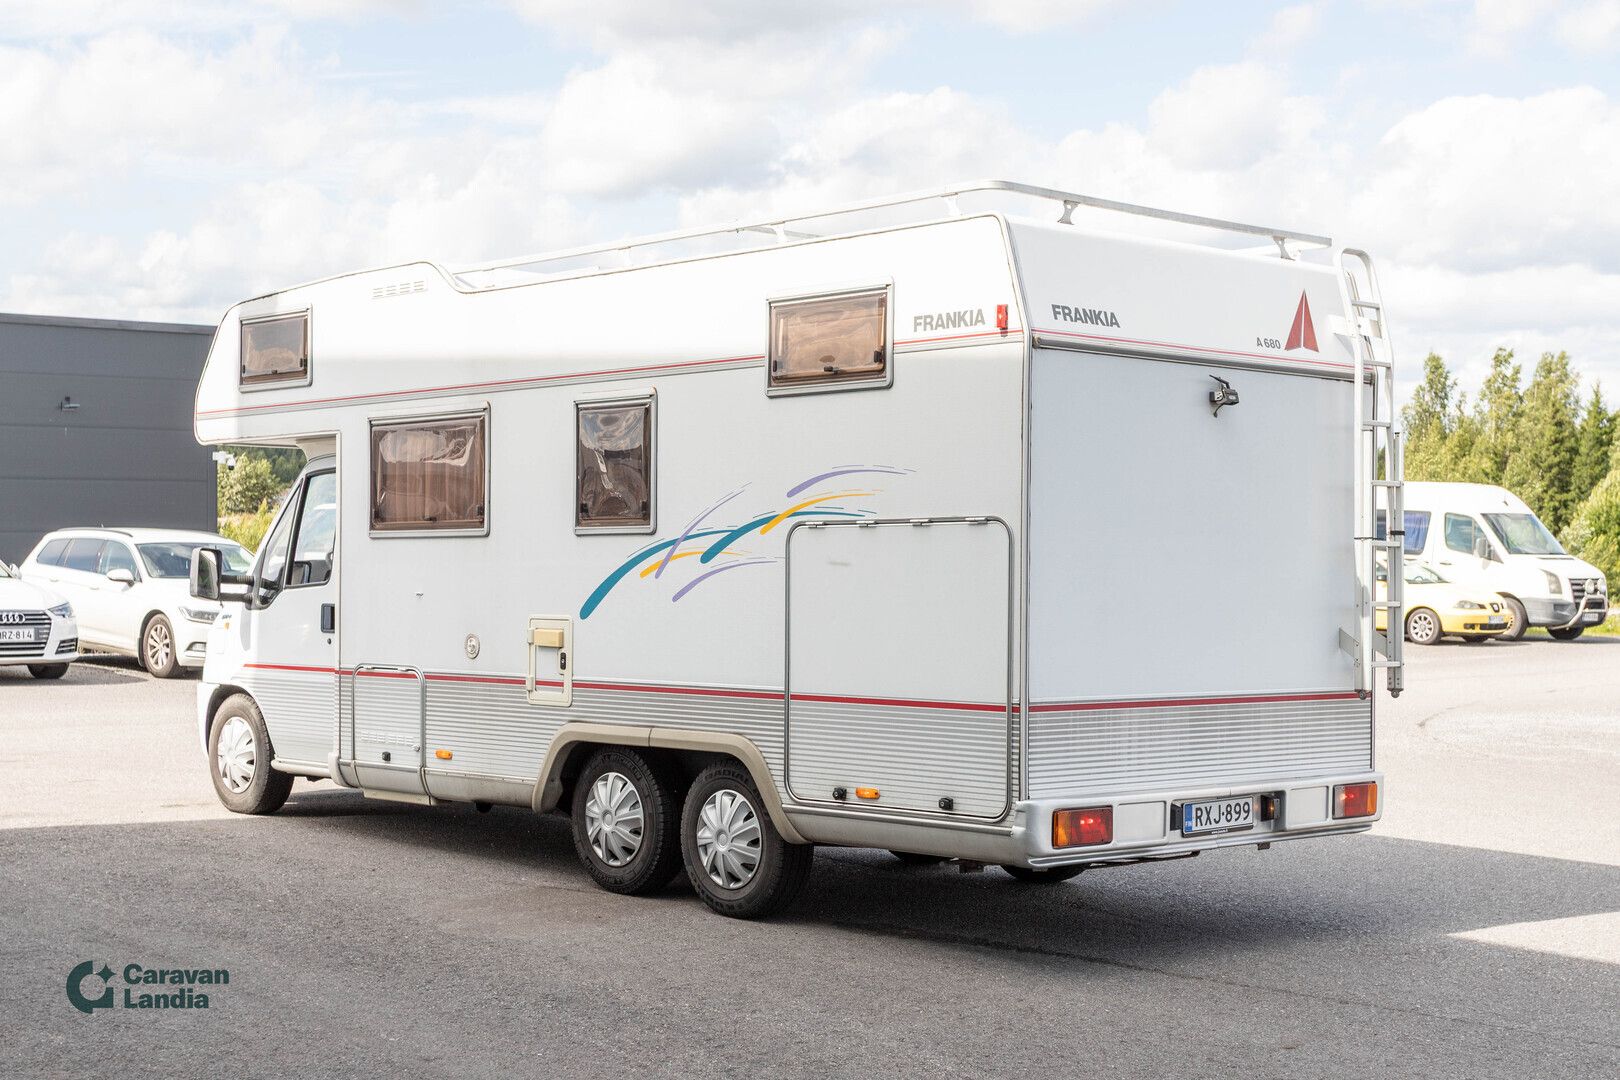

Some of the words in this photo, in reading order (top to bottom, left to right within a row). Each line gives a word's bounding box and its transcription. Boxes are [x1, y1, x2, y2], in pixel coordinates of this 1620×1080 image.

[913, 308, 986, 332] FRANKIA
[1051, 304, 1121, 328] FRANKIA
[1256, 337, 1264, 348] A
[1263, 338, 1281, 349] 680
[0, 630, 32, 640] RZ-814
[1195, 801, 1250, 827] RXJ-899
